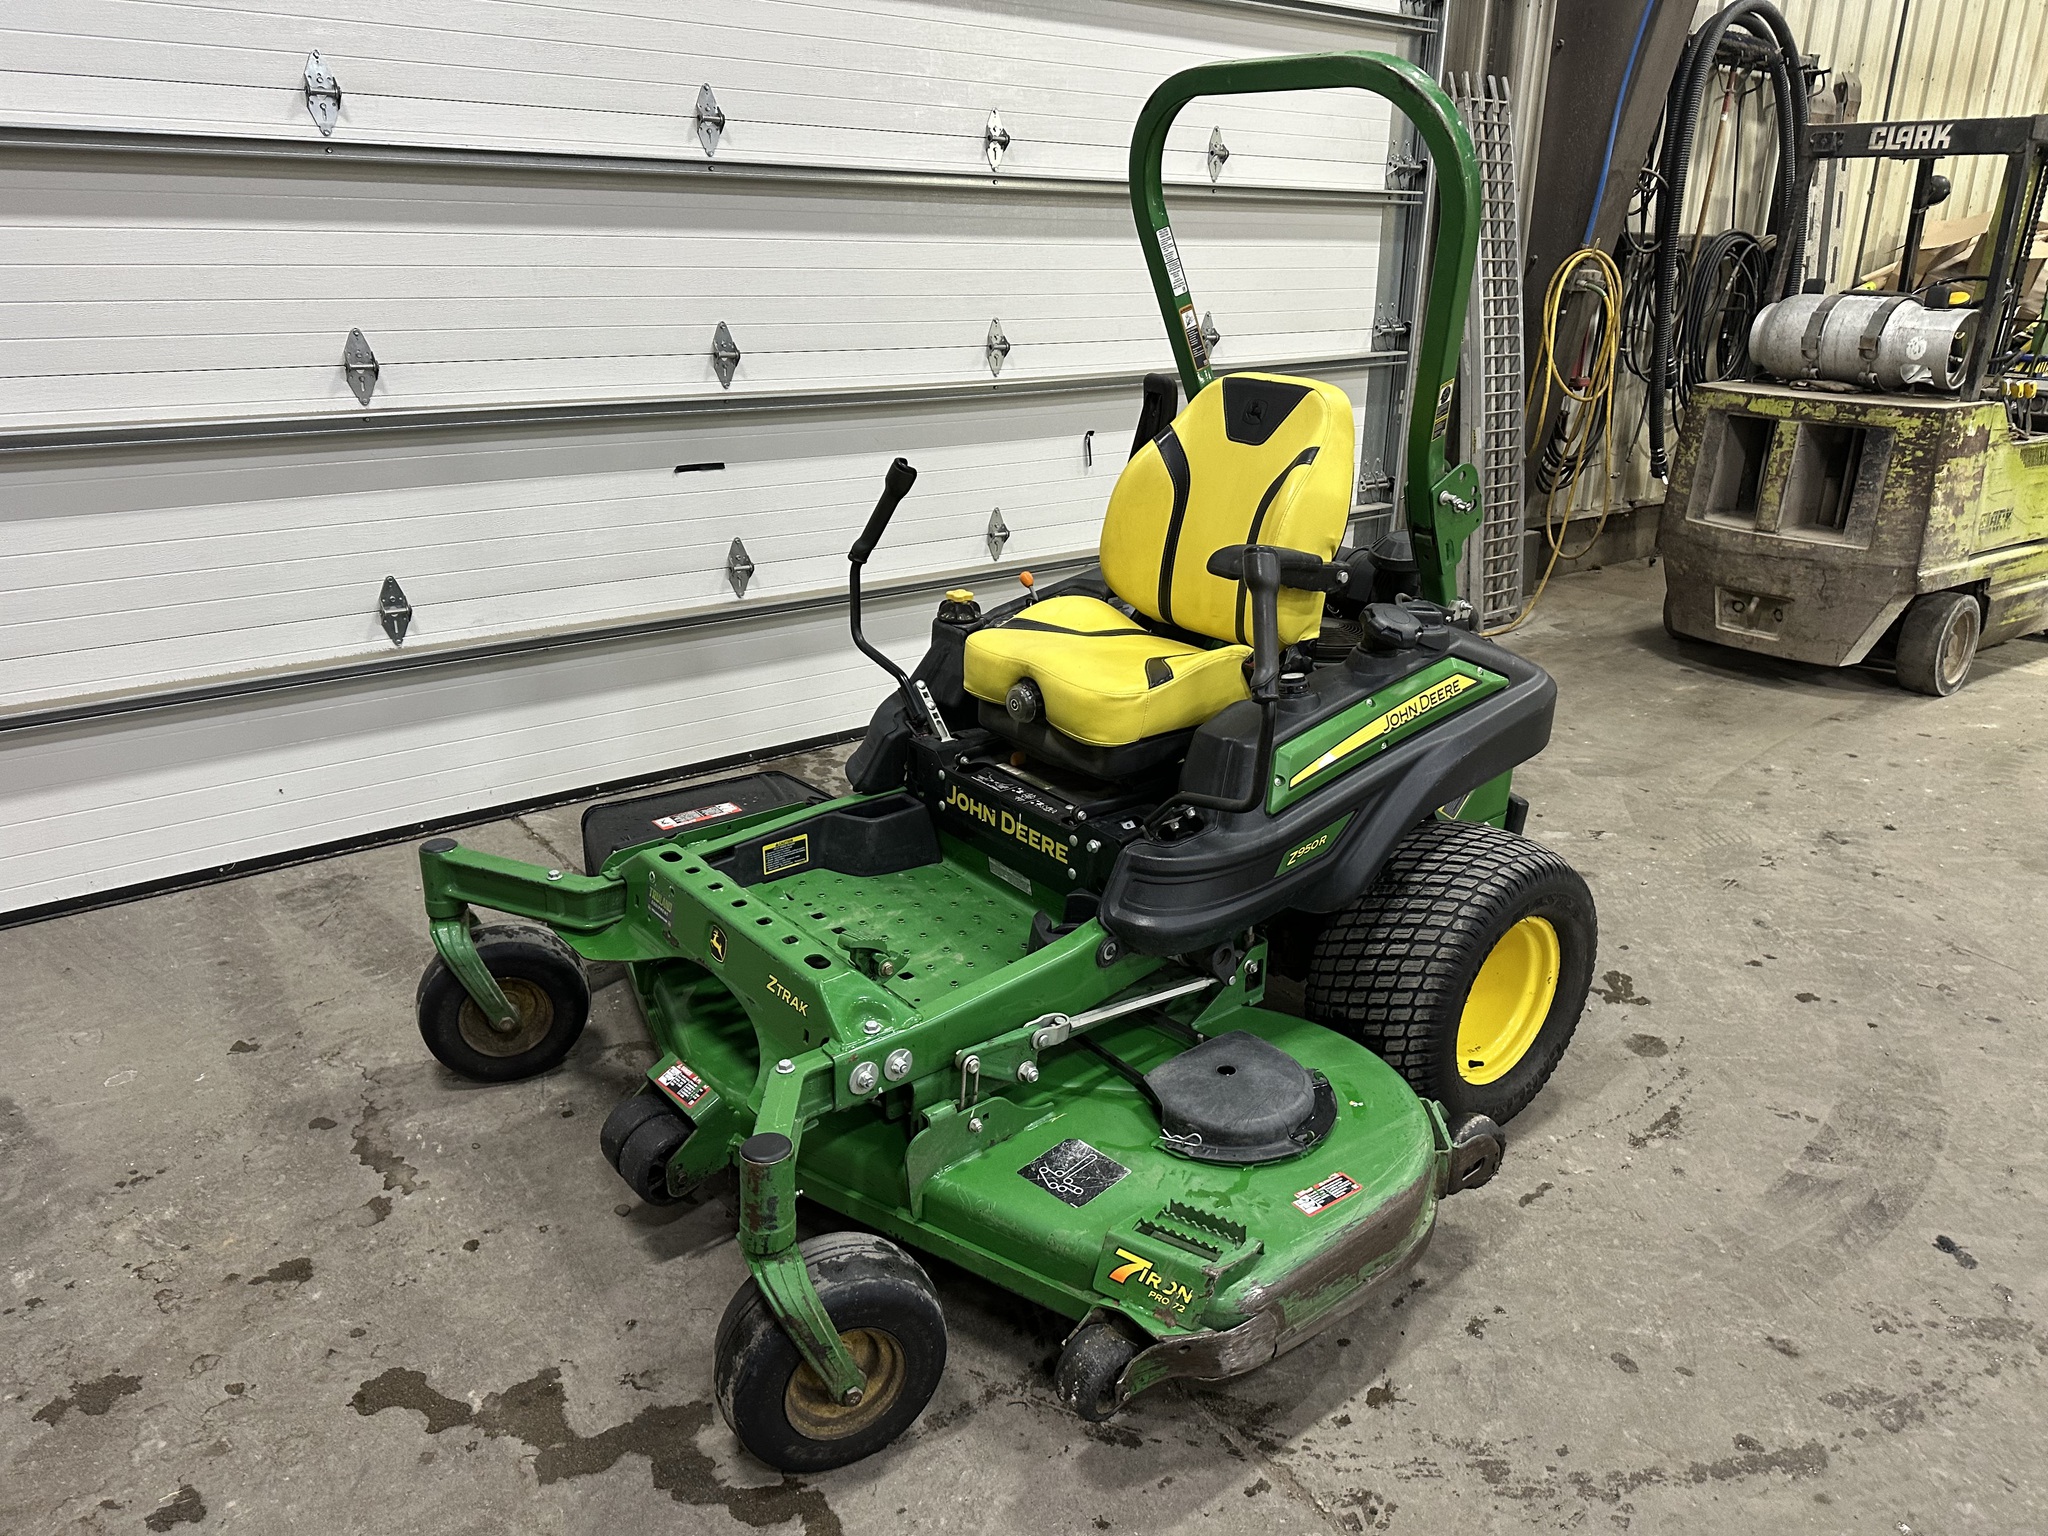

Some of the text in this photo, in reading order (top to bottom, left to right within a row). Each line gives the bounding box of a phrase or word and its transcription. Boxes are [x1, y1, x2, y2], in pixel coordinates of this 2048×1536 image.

[1868, 123, 1954, 151] CLARK
[1383, 679, 1461, 731] JOHN DEERE
[946, 785, 1069, 864] JOHN DEERE
[1286, 834, 1327, 866] Z950R
[766, 974, 809, 1018] ZTRAK
[1147, 1290, 1186, 1313] PRO 72
